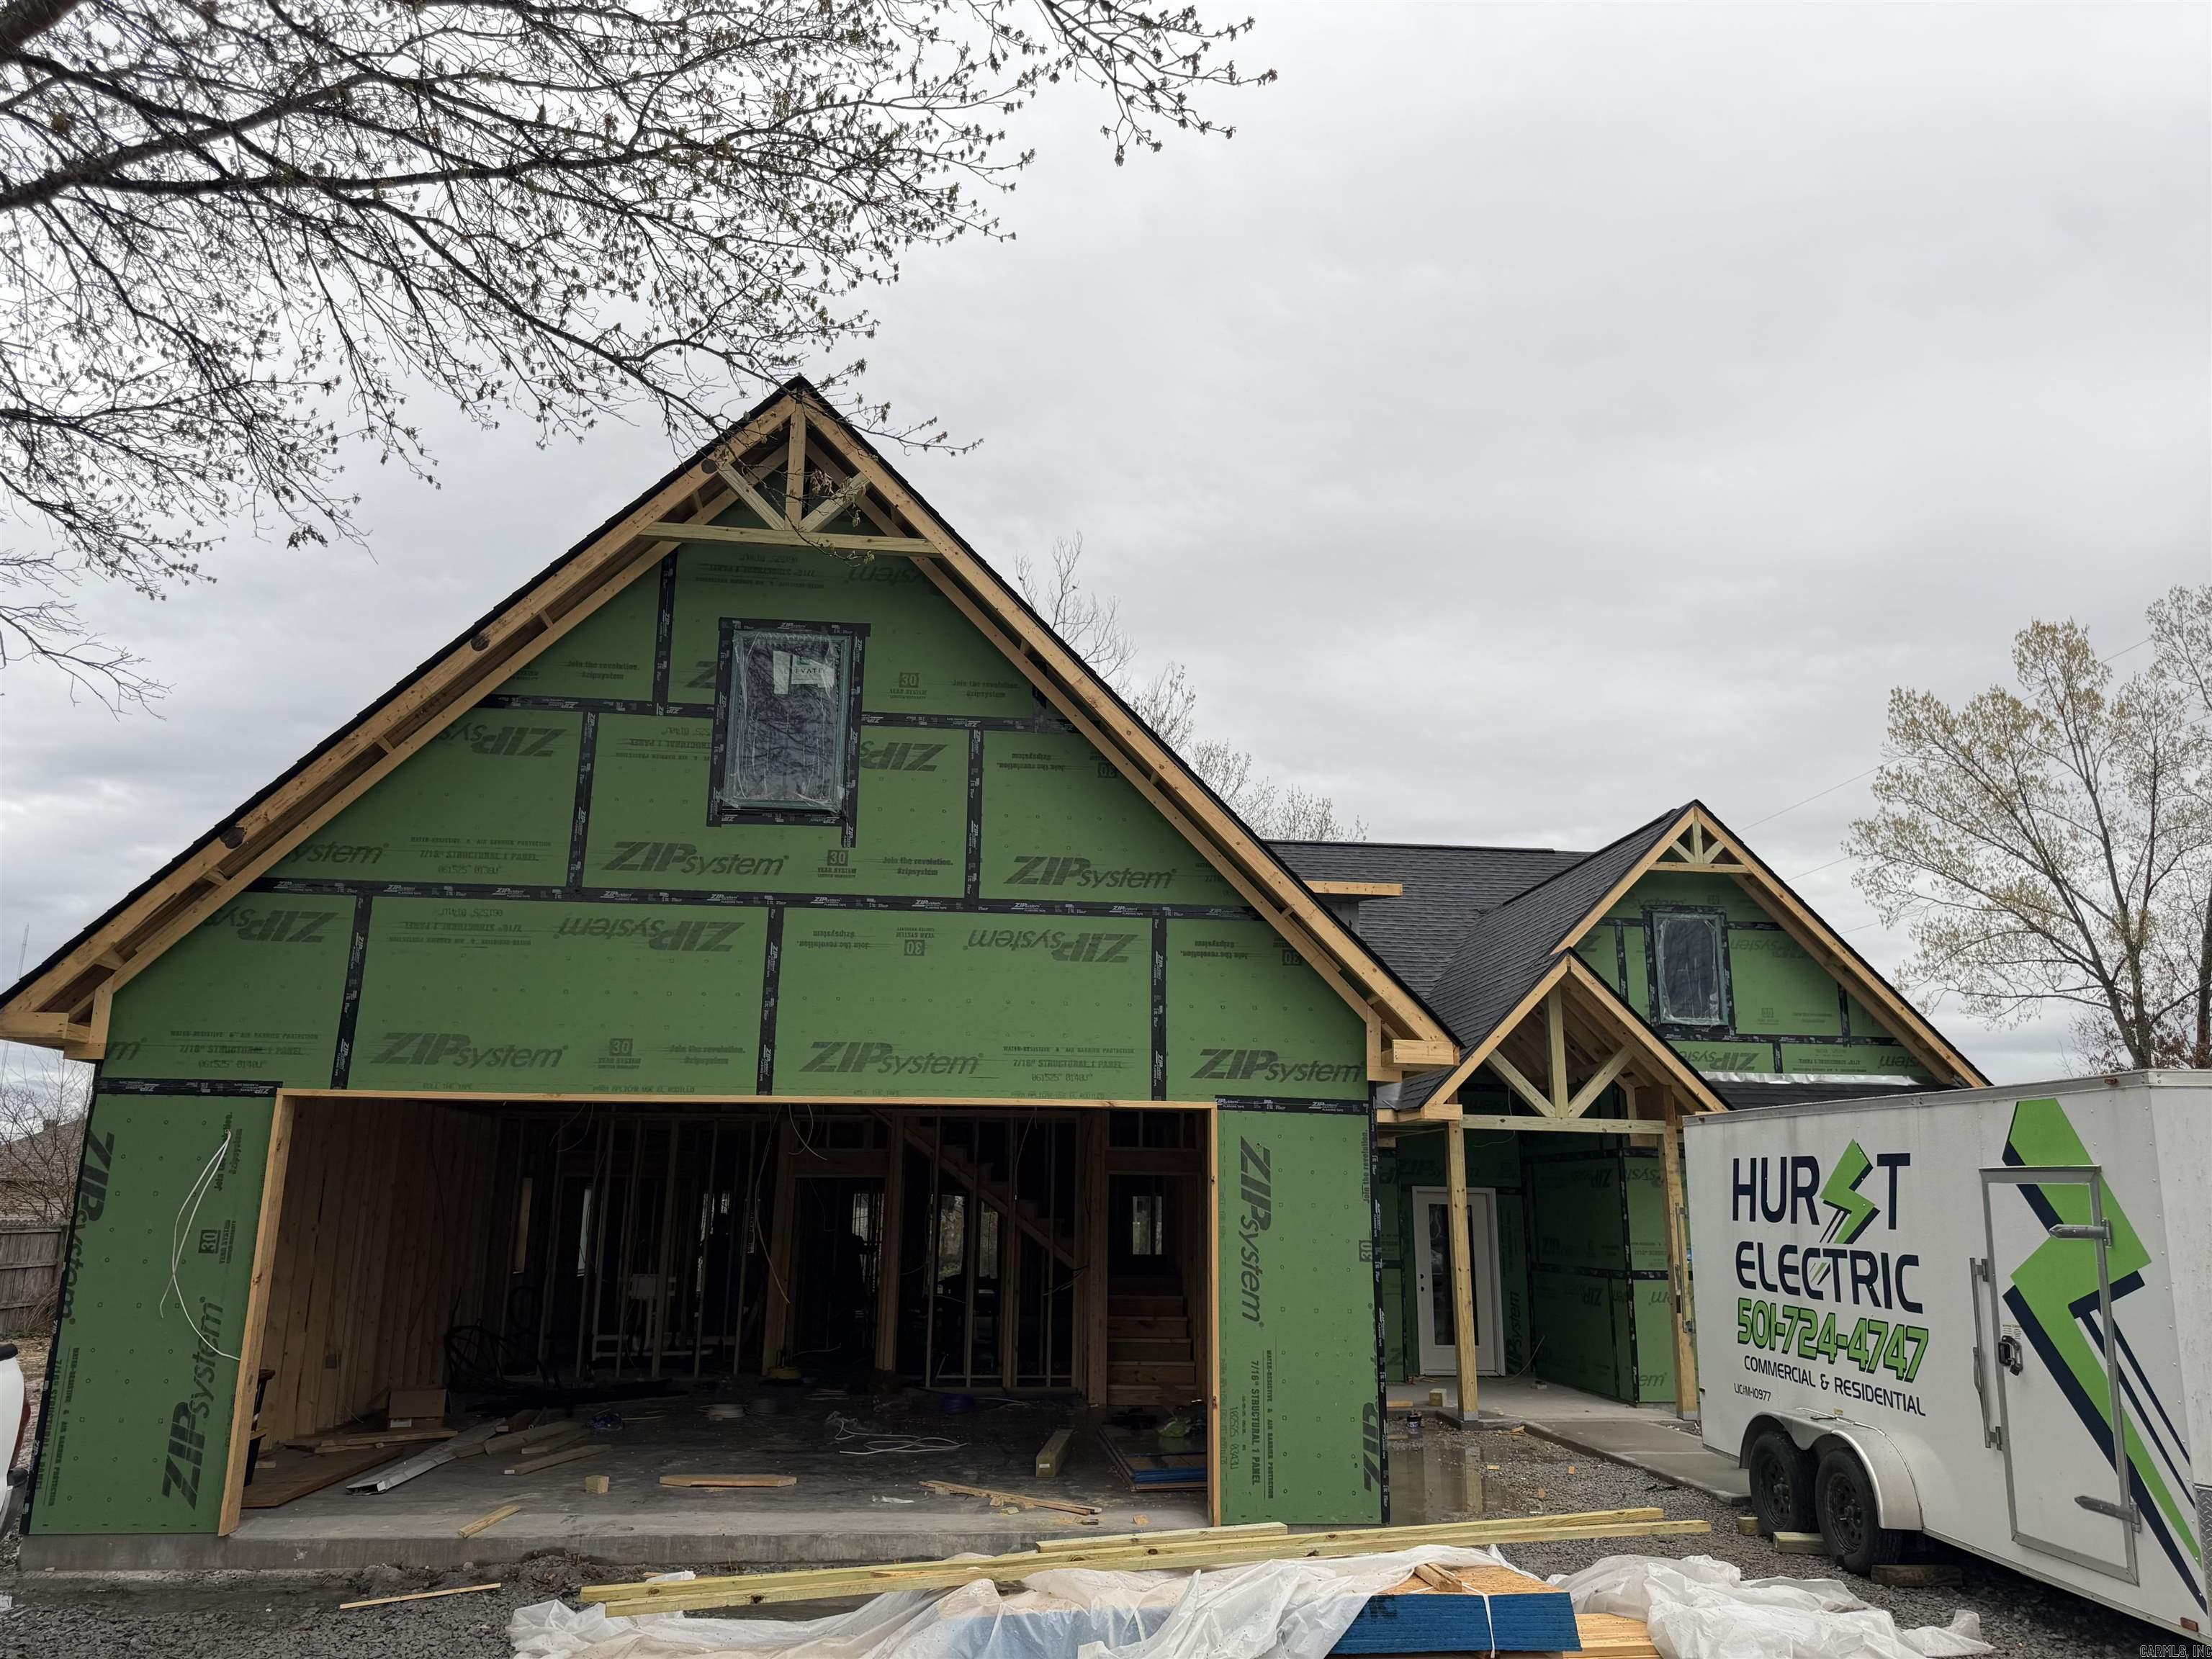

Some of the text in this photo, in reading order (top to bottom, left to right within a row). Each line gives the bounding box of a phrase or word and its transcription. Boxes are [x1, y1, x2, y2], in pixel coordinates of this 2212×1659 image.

[900, 674, 918, 687] 30
[601, 841, 785, 876] ZIPsystem
[829, 851, 847, 865] 30
[1003, 855, 1172, 888] ZIPsystem
[560, 917, 746, 952] ZIPsystem
[906, 941, 923, 955] 30
[968, 930, 1139, 963] ZIPsystem
[370, 1033, 565, 1069] ZIPsystem
[611, 1040, 631, 1054] 30
[799, 1041, 981, 1075] ZIPsystem
[1190, 1048, 1362, 1082] ZIPsystem
[201, 1231, 219, 1251] 30
[1238, 1135, 1272, 1323] ZIPsystem
[1735, 1241, 1923, 1314] ELECTRIC
[1737, 1298, 1929, 1383] 501-724-4747
[1744, 1355, 1926, 1417] COMMERCIAL & RESIDENTIAL
[161, 1303, 223, 1511] ZIPsystem
[1251, 1388, 1260, 1445] STRUCTURAL
[1251, 1456, 1260, 1486] PANEL
